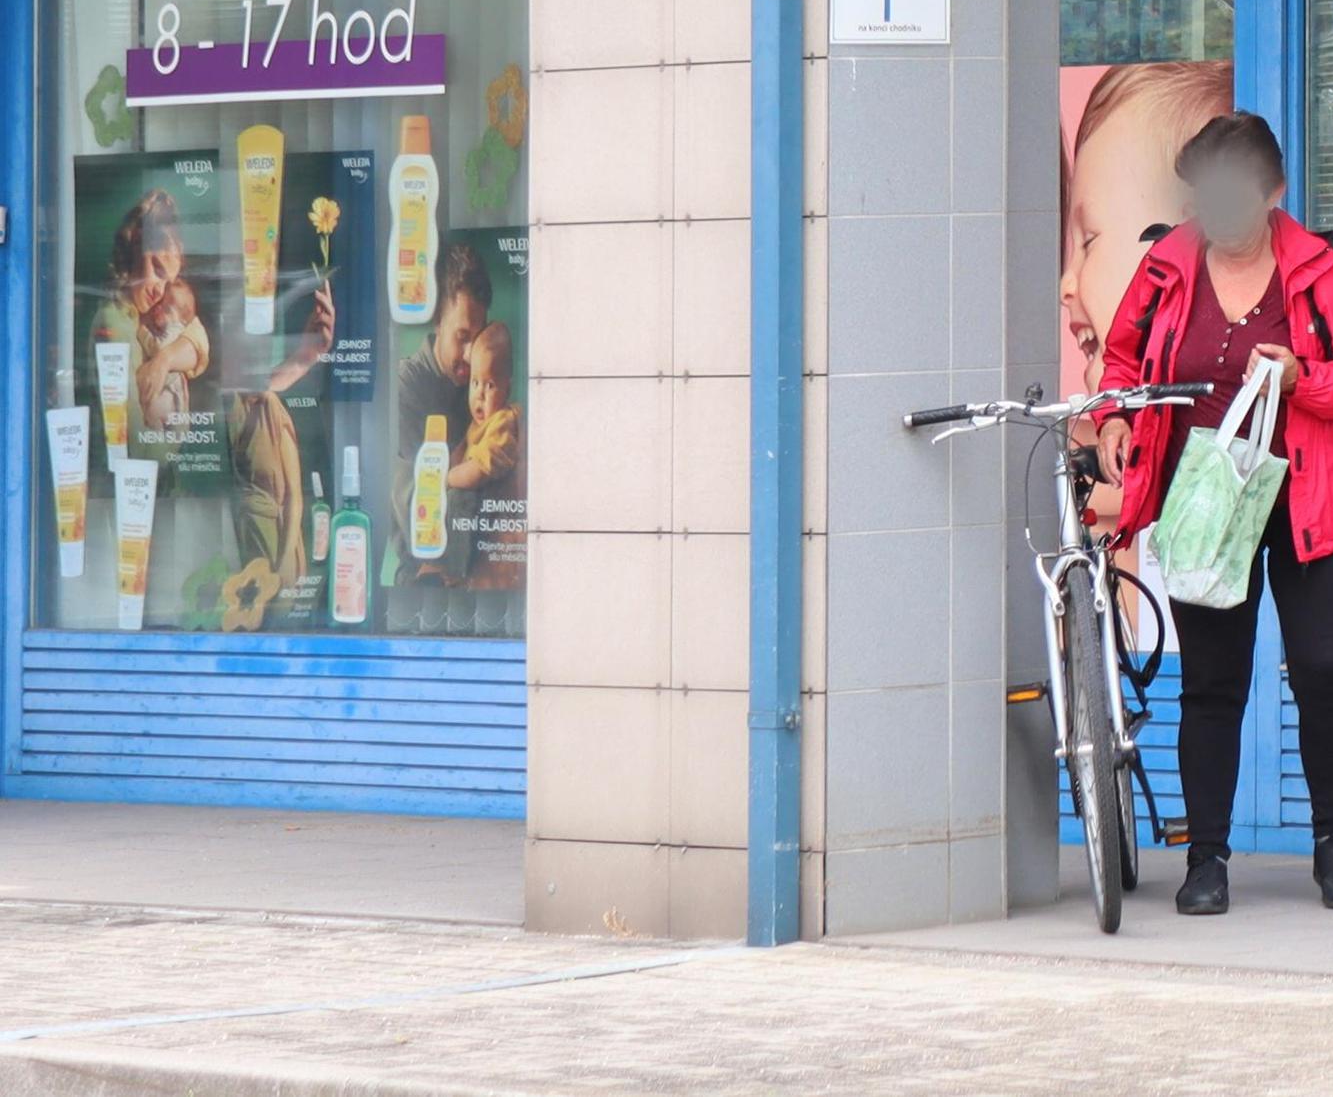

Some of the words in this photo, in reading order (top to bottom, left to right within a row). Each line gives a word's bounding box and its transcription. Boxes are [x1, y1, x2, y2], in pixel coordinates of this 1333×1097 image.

[153, 3, 180, 75] 8
[198, 40, 214, 49] -
[175, 160, 213, 174] WELEDA
[342, 157, 370, 168] WELEDA
[337, 339, 371, 349] JEMNOST
[166, 412, 216, 425] JEMNOST
[138, 429, 165, 443] NENÍ
[166, 431, 218, 443] SLABOST.
[452, 515, 479, 531] NENÍ
